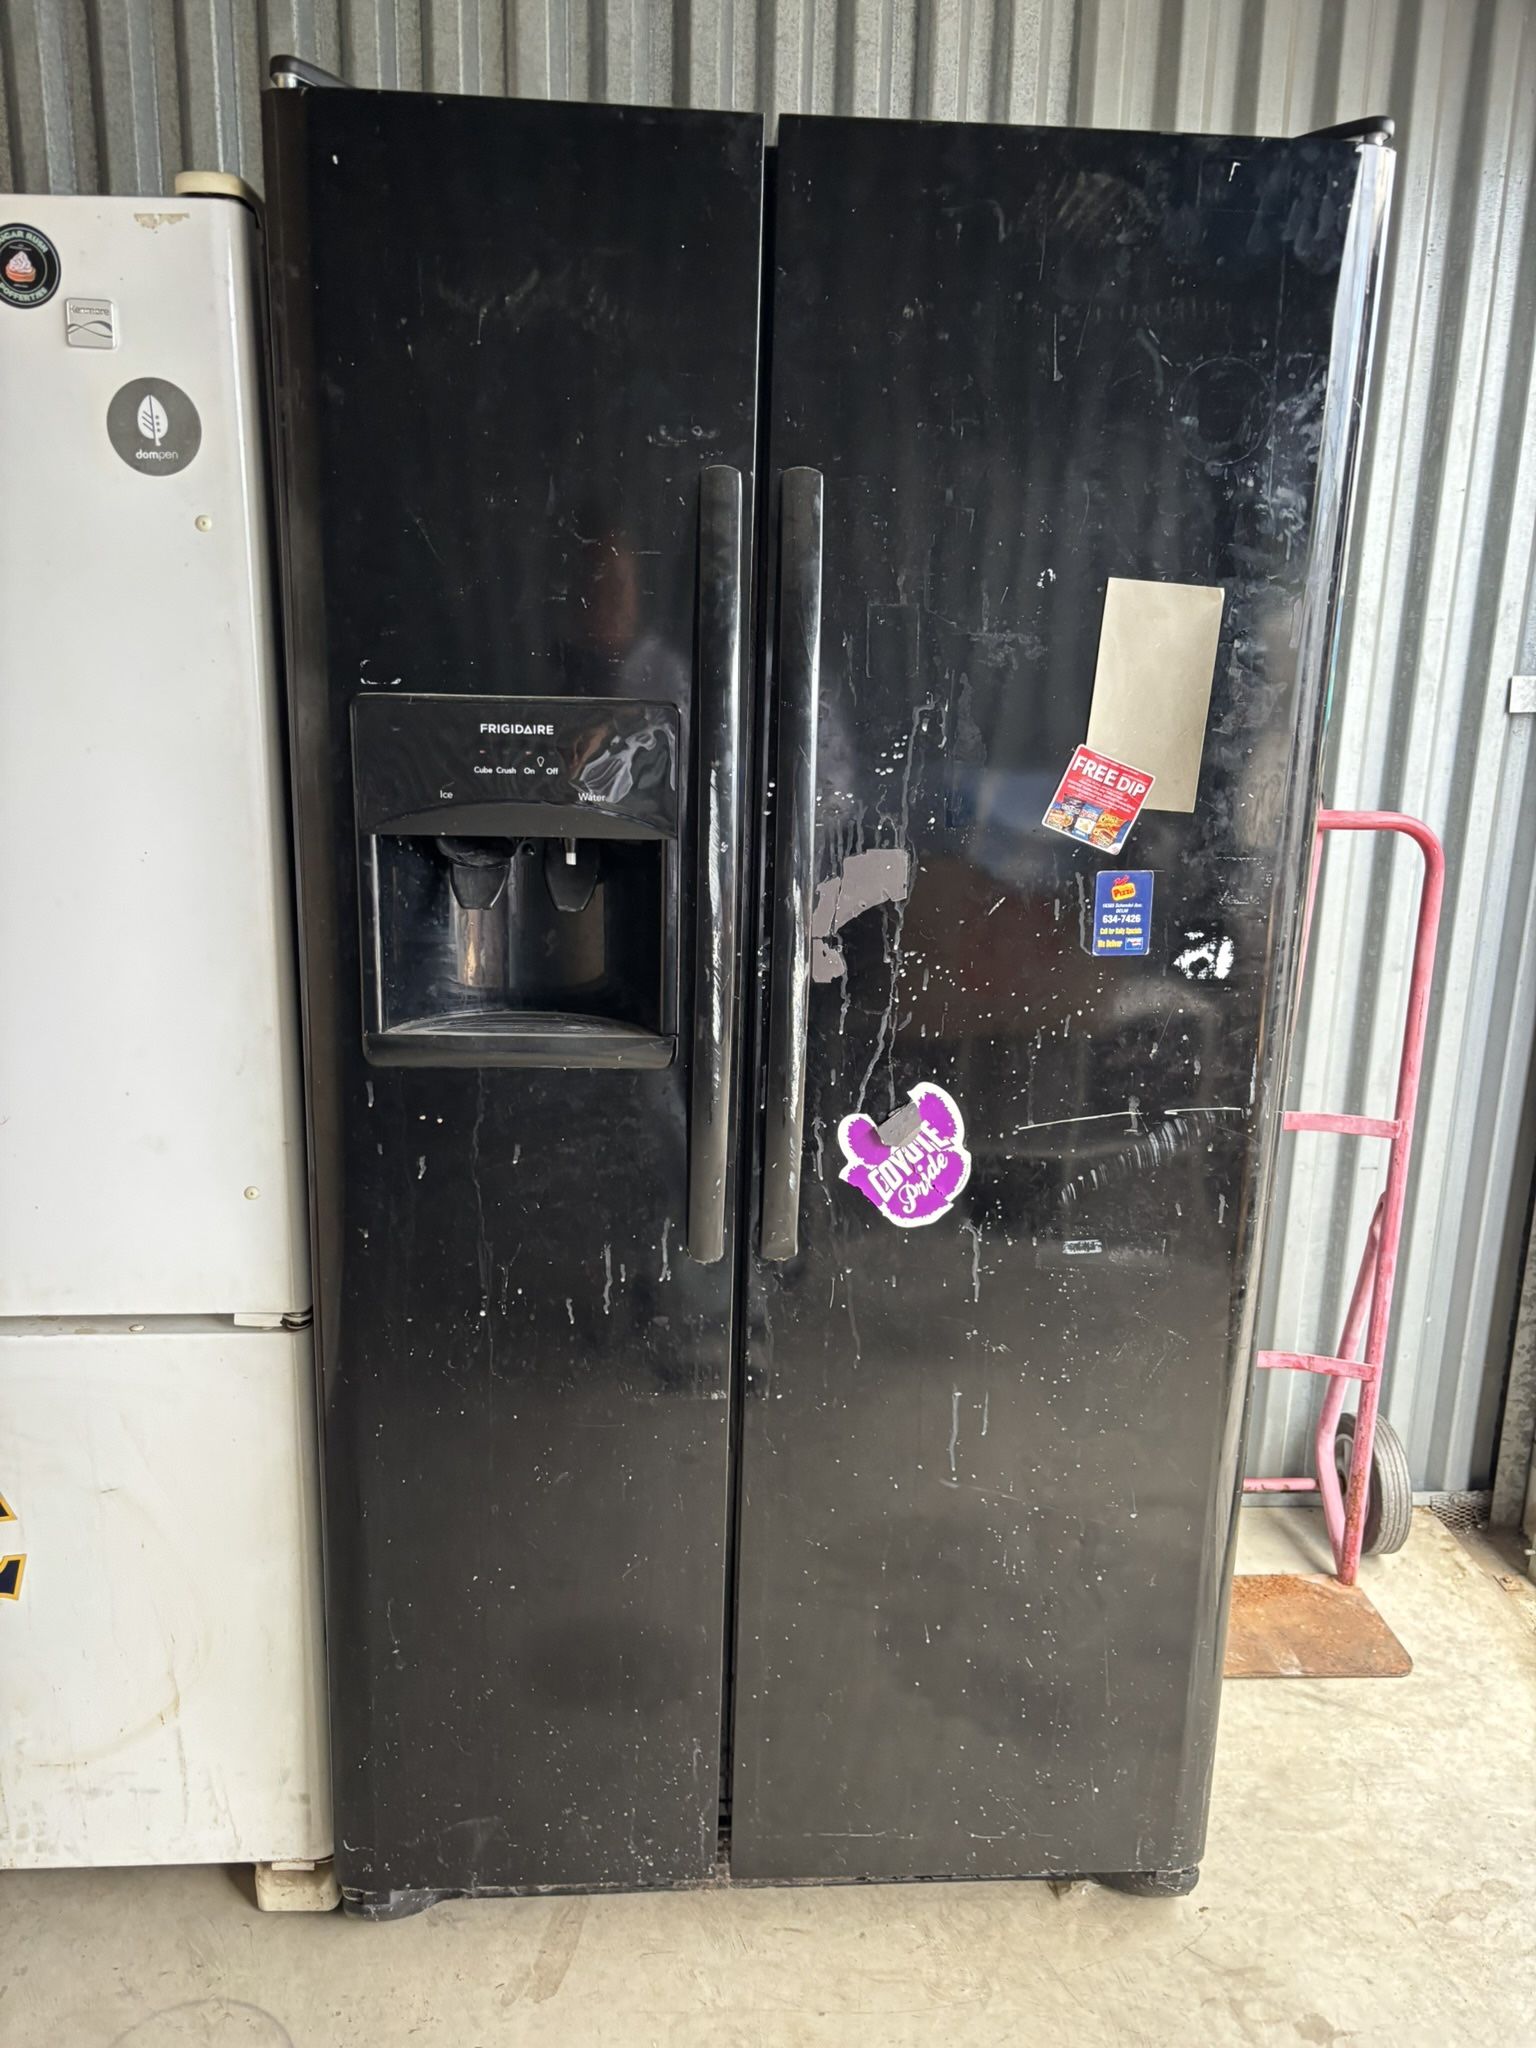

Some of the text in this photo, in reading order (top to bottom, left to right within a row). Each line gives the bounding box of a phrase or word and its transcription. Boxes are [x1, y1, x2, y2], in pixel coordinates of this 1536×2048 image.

[0, 230, 49, 253] UGAR RUSH
[135, 448, 179, 461] dompen
[480, 723, 554, 735] FRIGIDAIRE
[474, 766, 559, 775] Cube Crush On Off
[1072, 755, 1120, 787] FREE
[1116, 775, 1146, 797] DIP
[440, 790, 454, 799] Ice
[578, 793, 606, 802] Water
[1102, 914, 1141, 924] 634-7426
[898, 1153, 949, 1214] Pride
